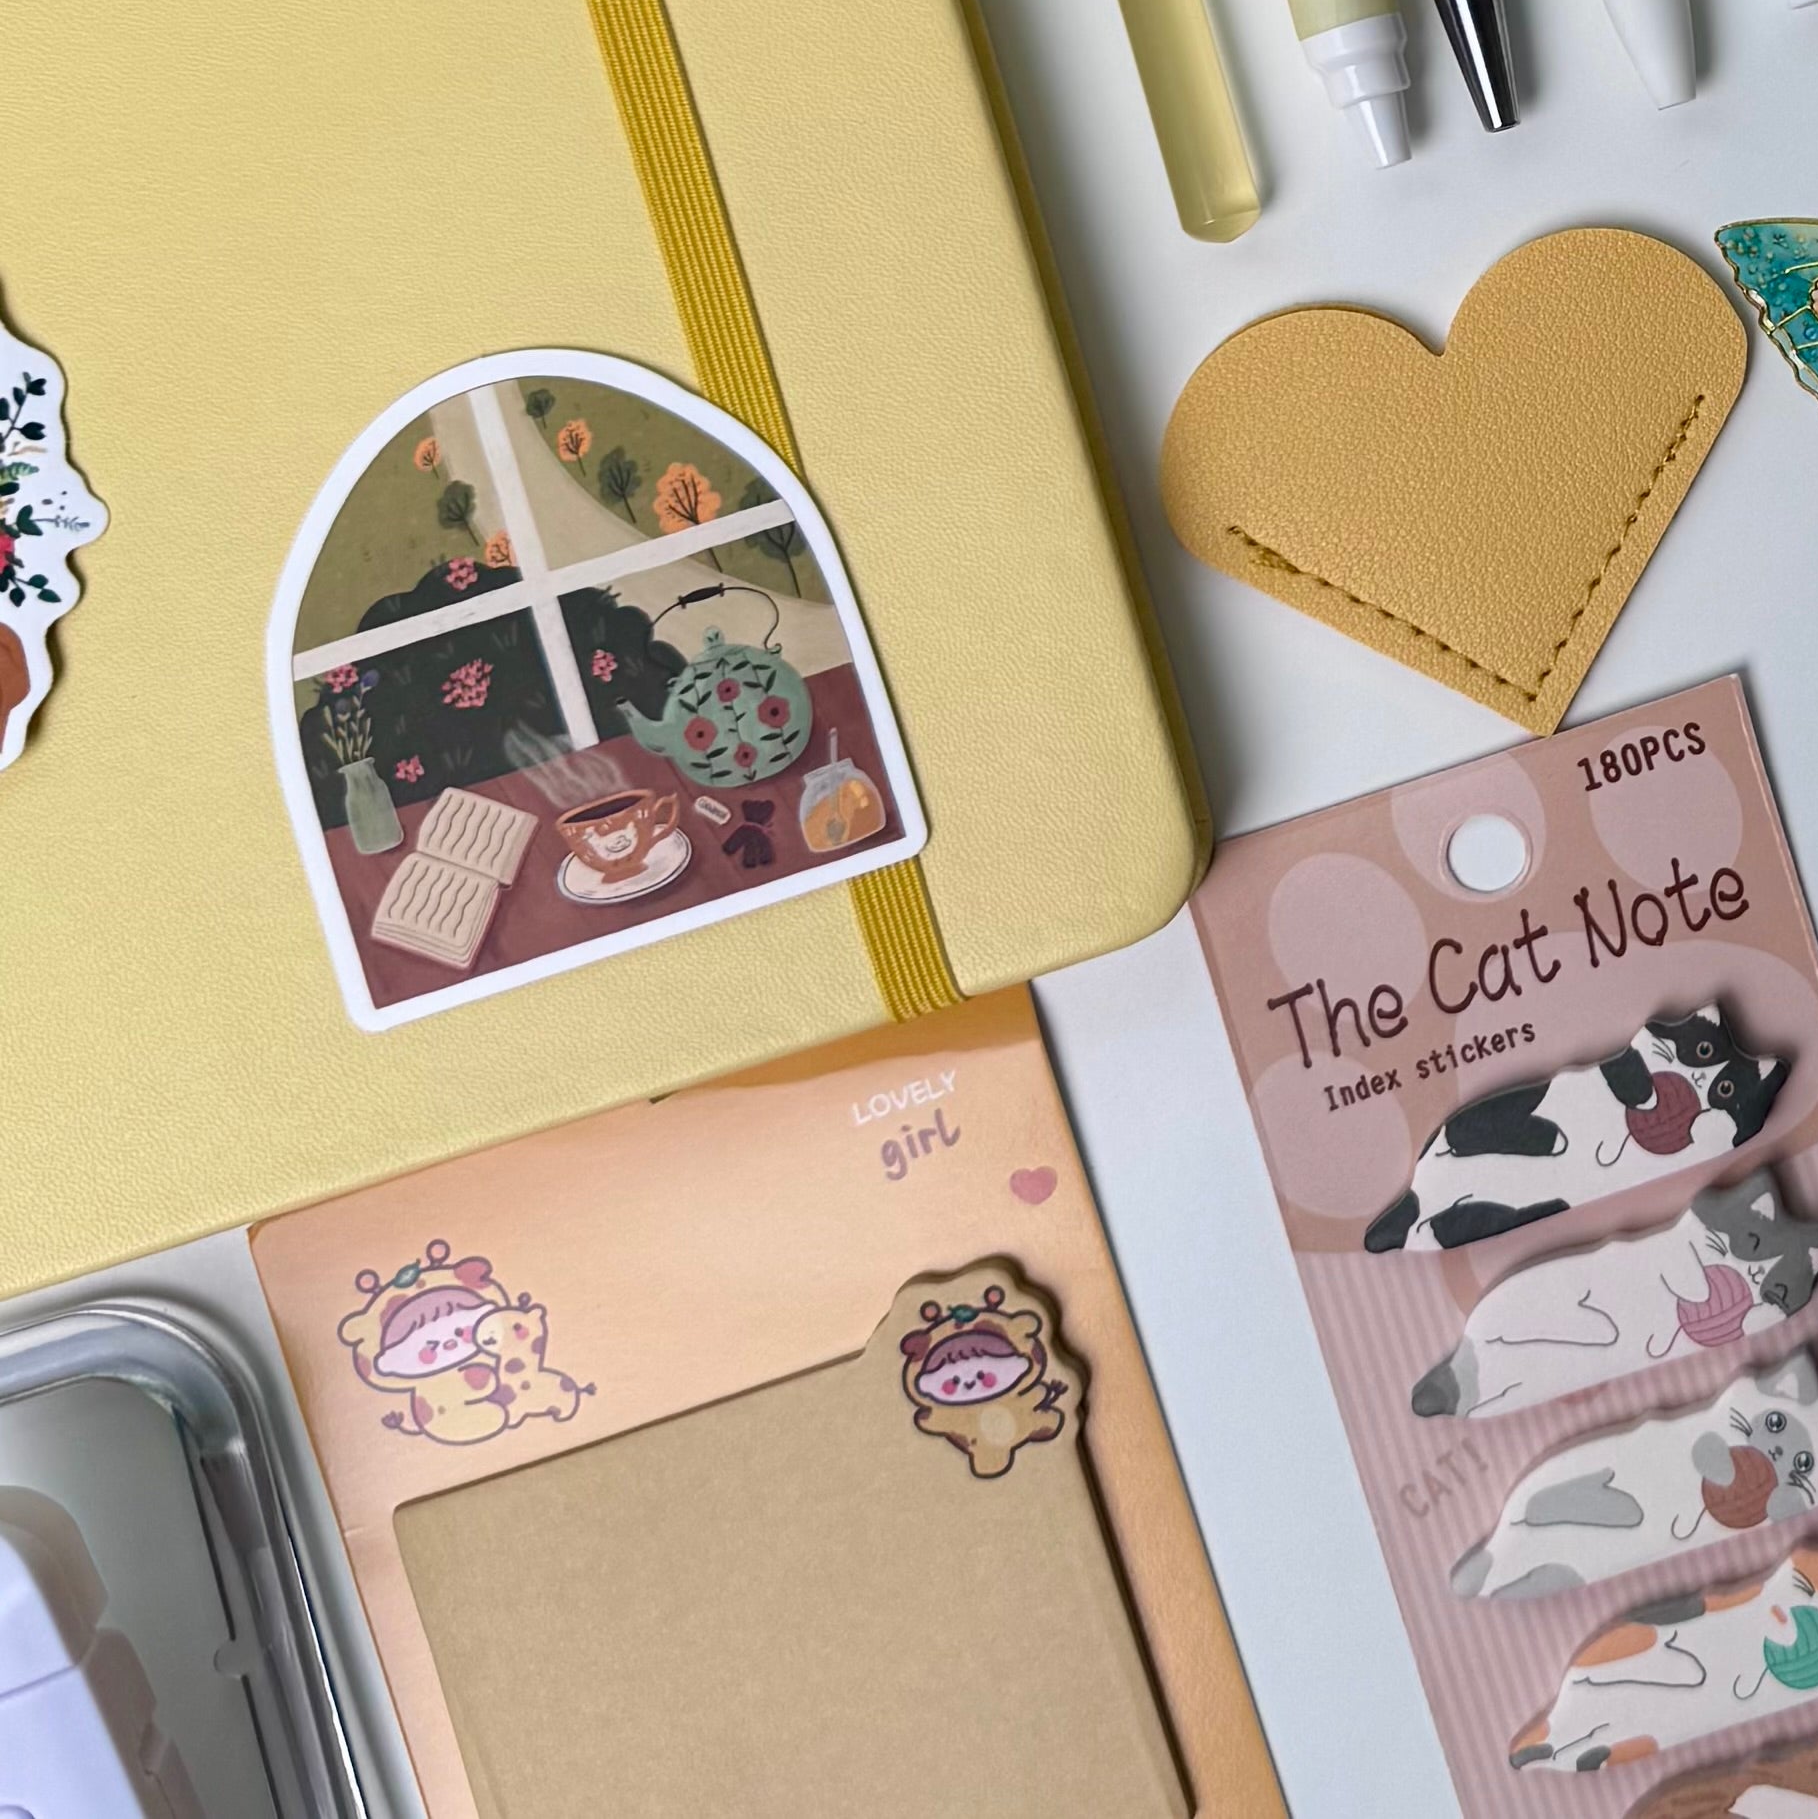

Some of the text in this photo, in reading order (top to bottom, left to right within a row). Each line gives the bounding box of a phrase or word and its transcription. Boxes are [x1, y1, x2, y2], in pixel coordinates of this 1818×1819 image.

[1576, 721, 1707, 793] 180PCS
[1267, 857, 1750, 1070] The Cat Note
[851, 1069, 957, 1126] LOVELY
[1323, 1021, 1537, 1112] Index stickers
[880, 1107, 962, 1181] girl
